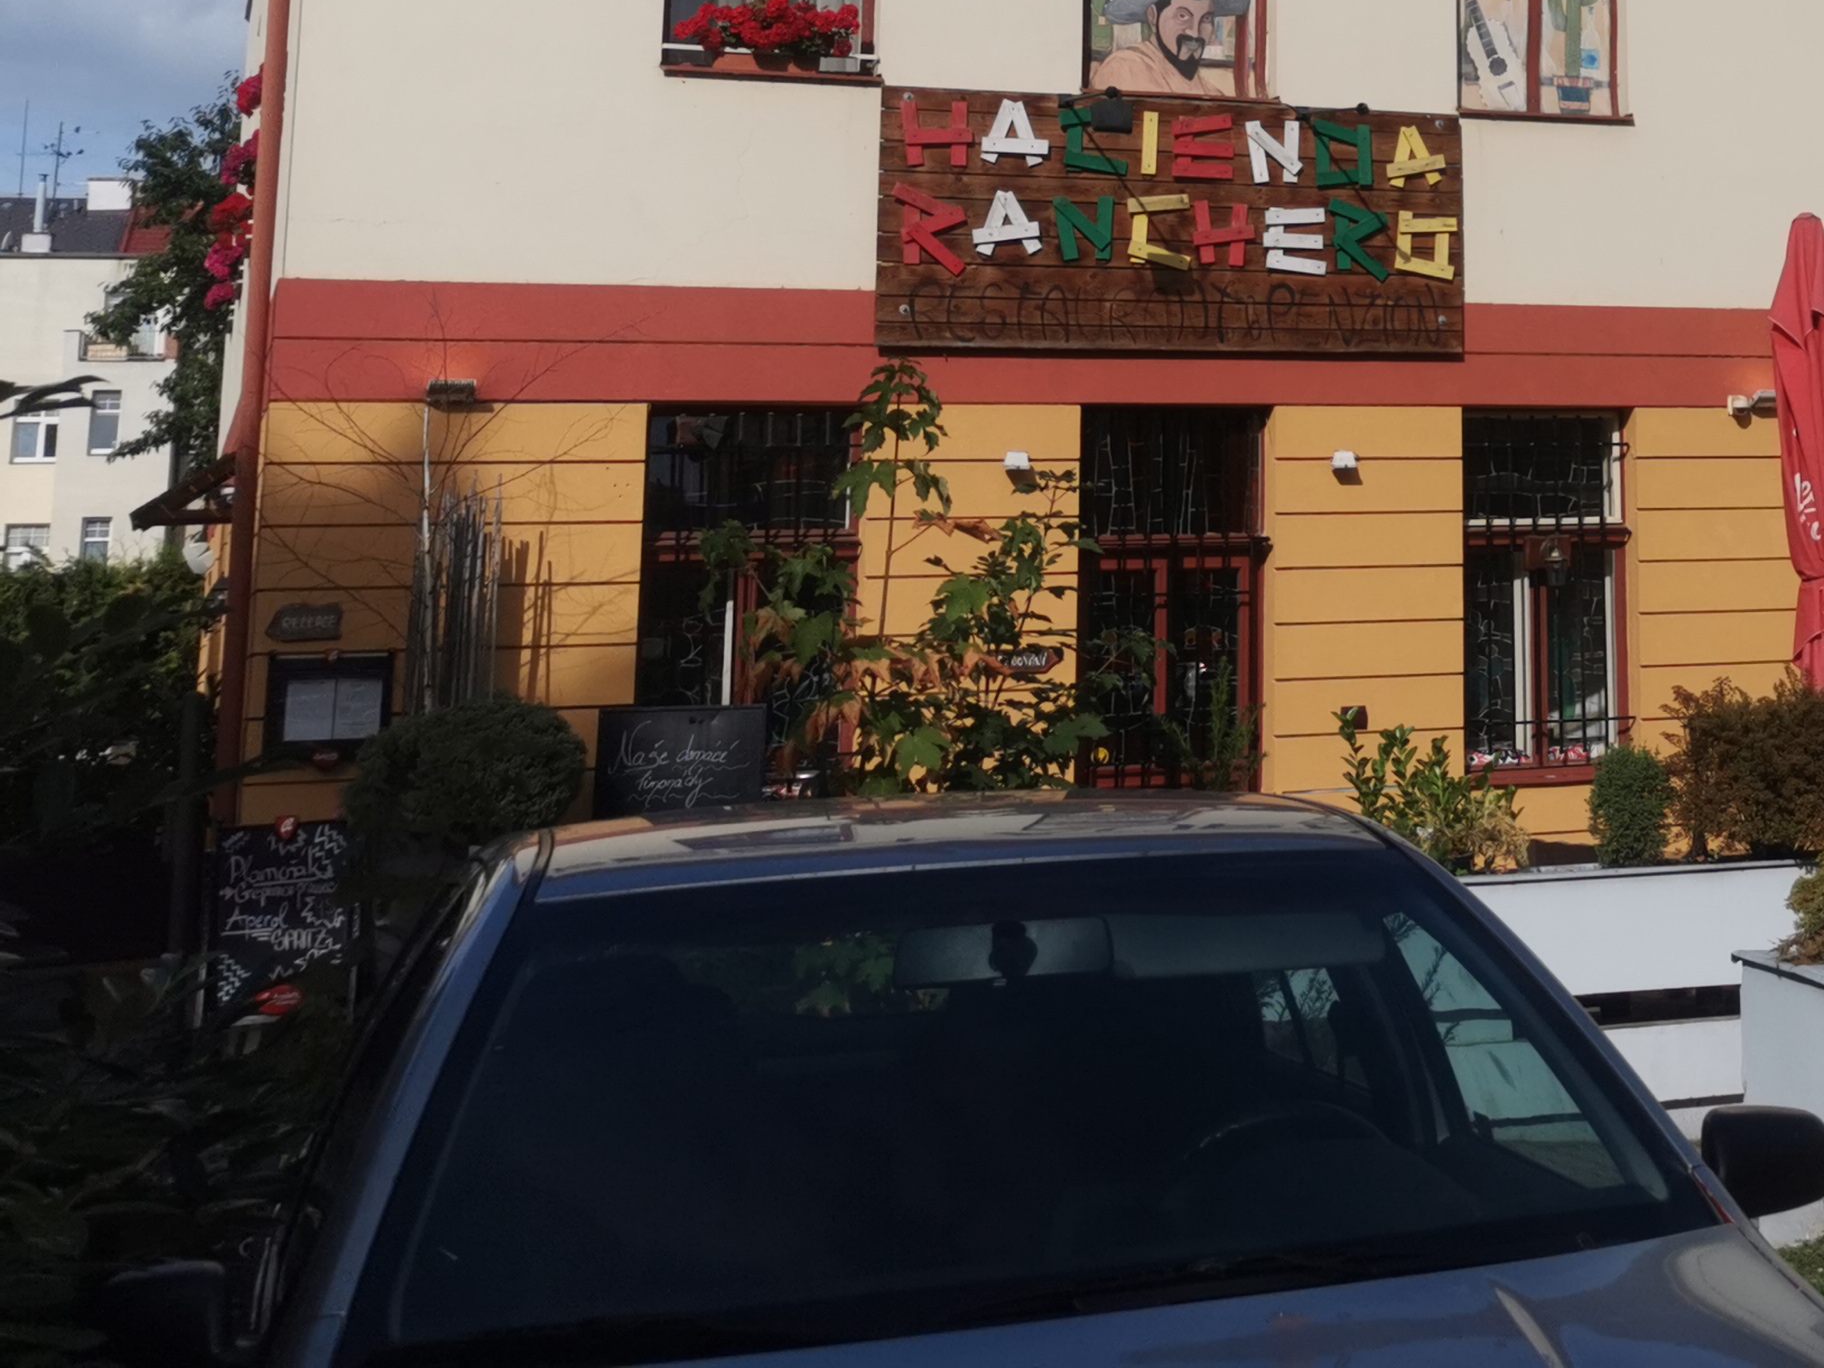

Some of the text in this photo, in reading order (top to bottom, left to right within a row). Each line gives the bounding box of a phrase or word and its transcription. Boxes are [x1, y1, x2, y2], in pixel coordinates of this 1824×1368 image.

[902, 98, 1447, 188] HACIENDA
[891, 182, 1457, 282] RANCHERO
[225, 901, 288, 940] Aperol
